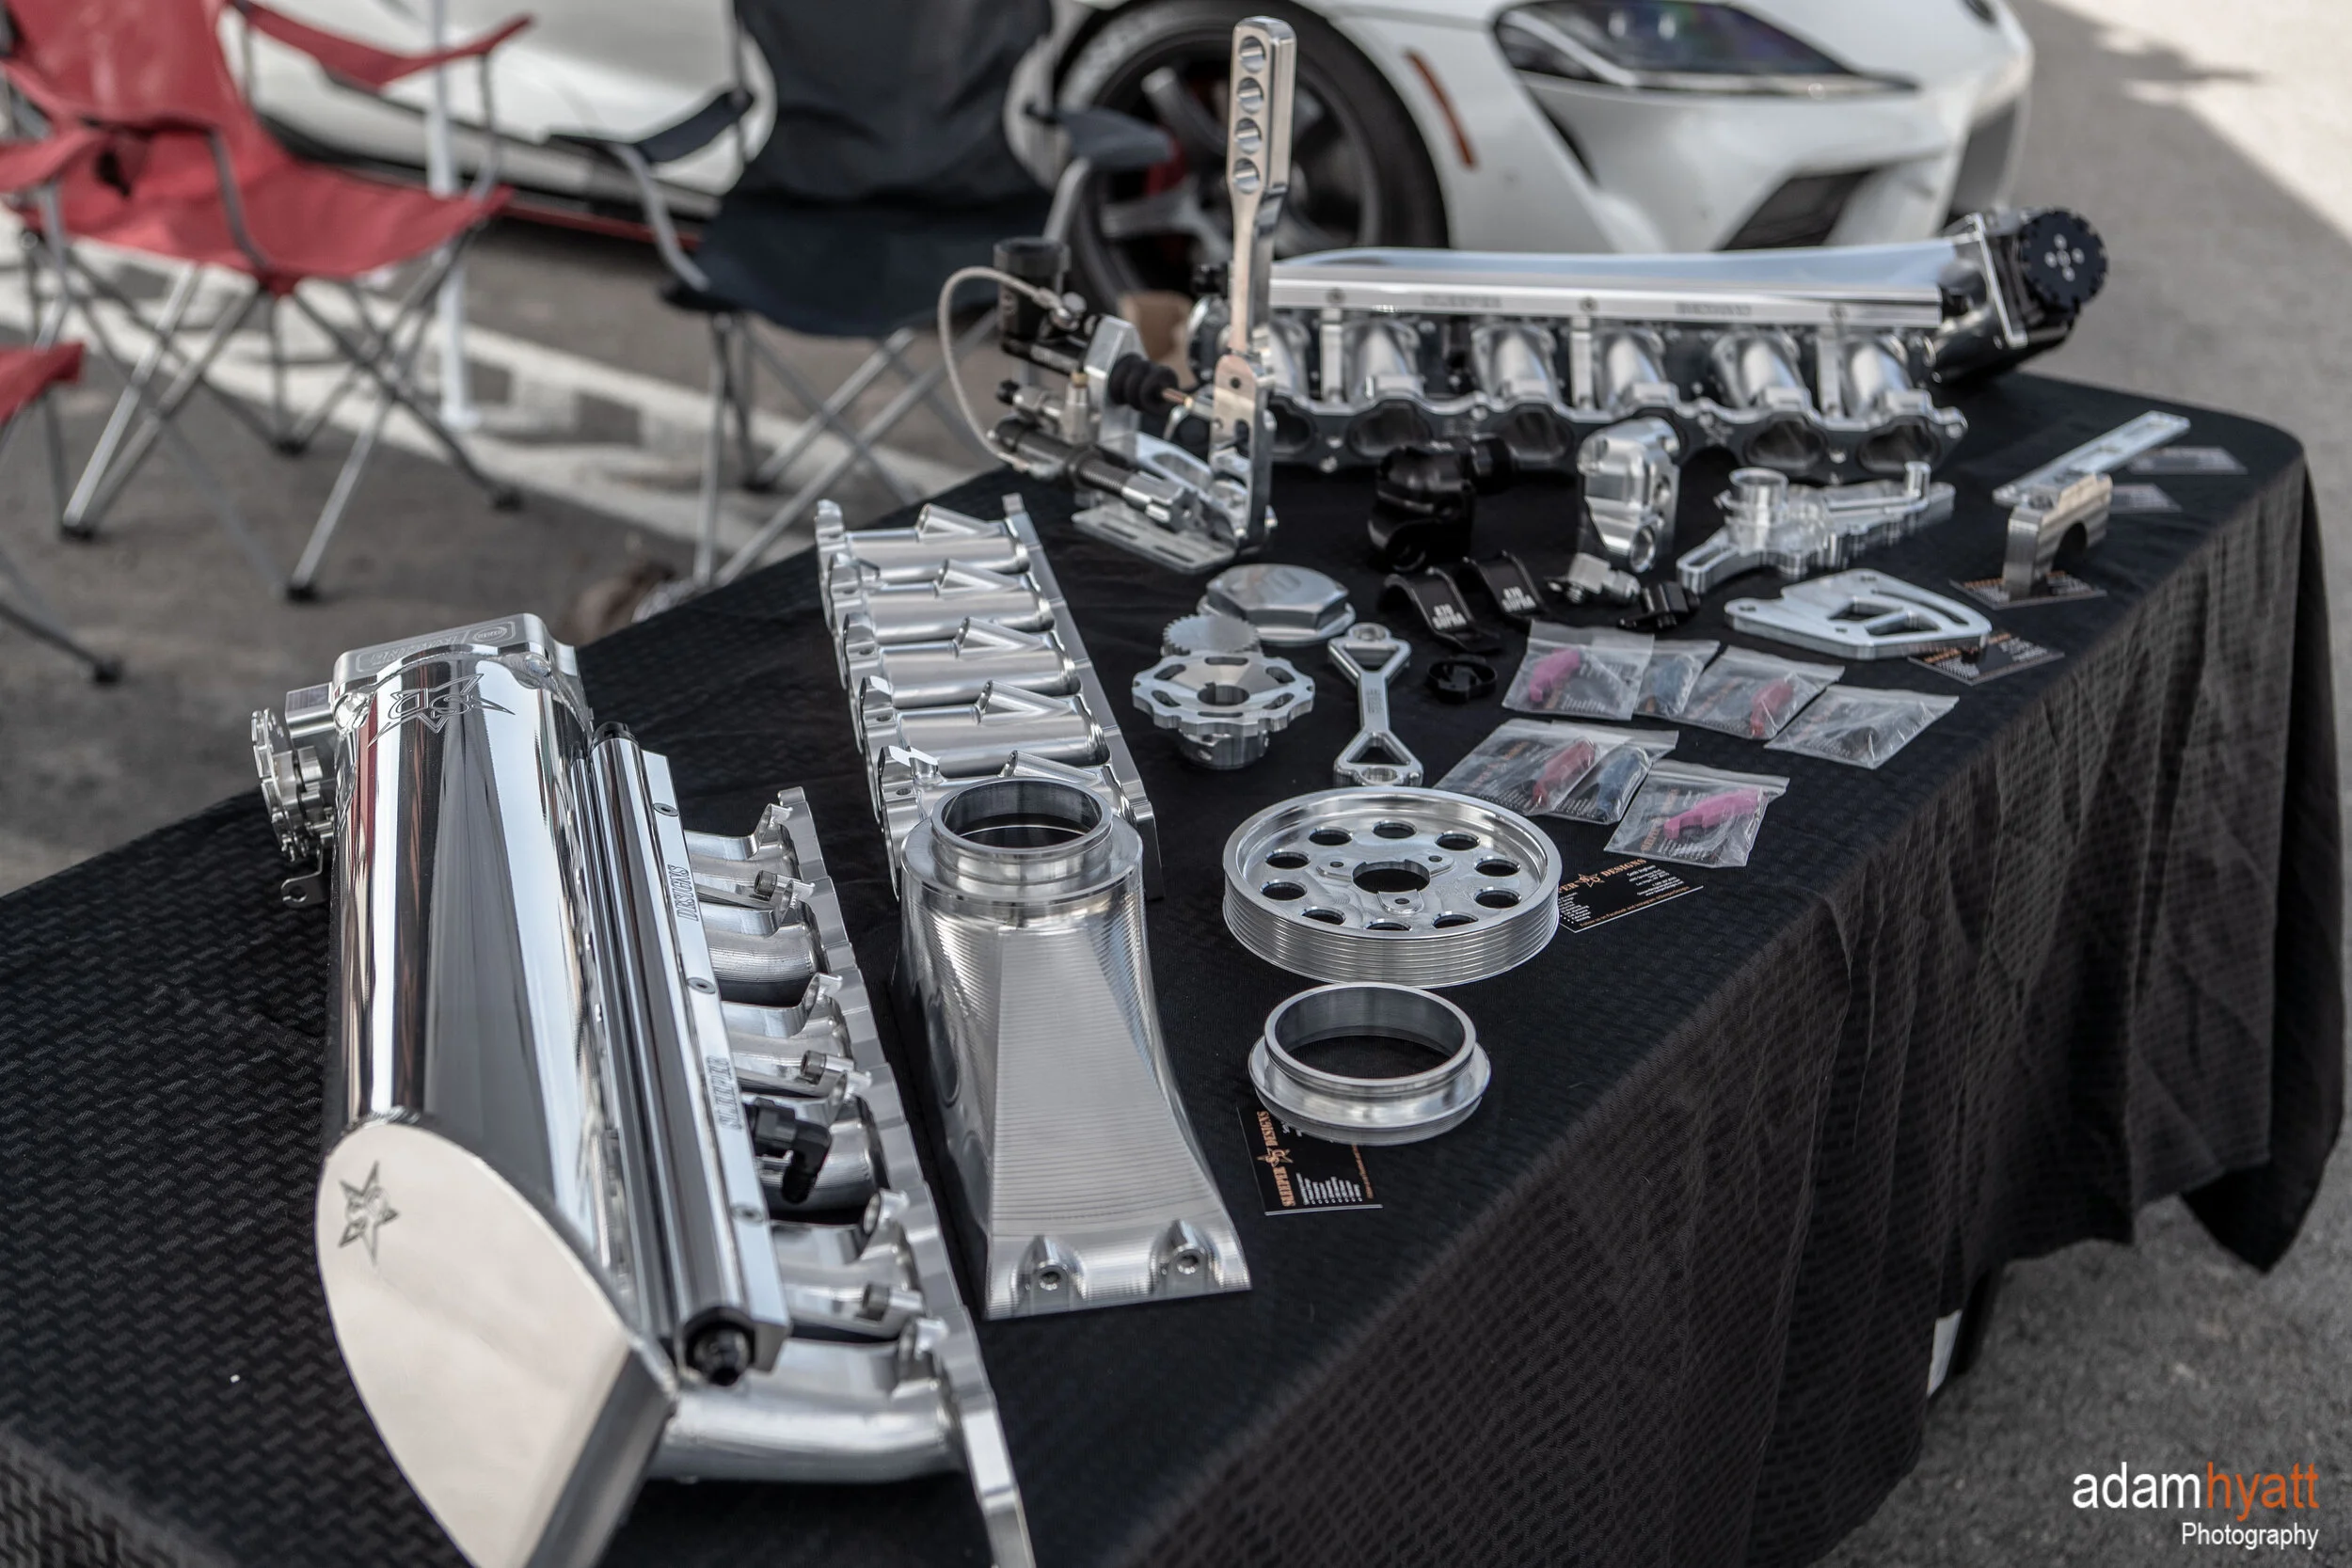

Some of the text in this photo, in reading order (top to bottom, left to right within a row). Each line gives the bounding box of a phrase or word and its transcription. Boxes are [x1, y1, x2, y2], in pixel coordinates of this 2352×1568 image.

[1600, 858, 1646, 878] DESIGNS
[666, 863, 700, 922] DESIGNS
[1257, 1110, 1279, 1147] DESIGNS
